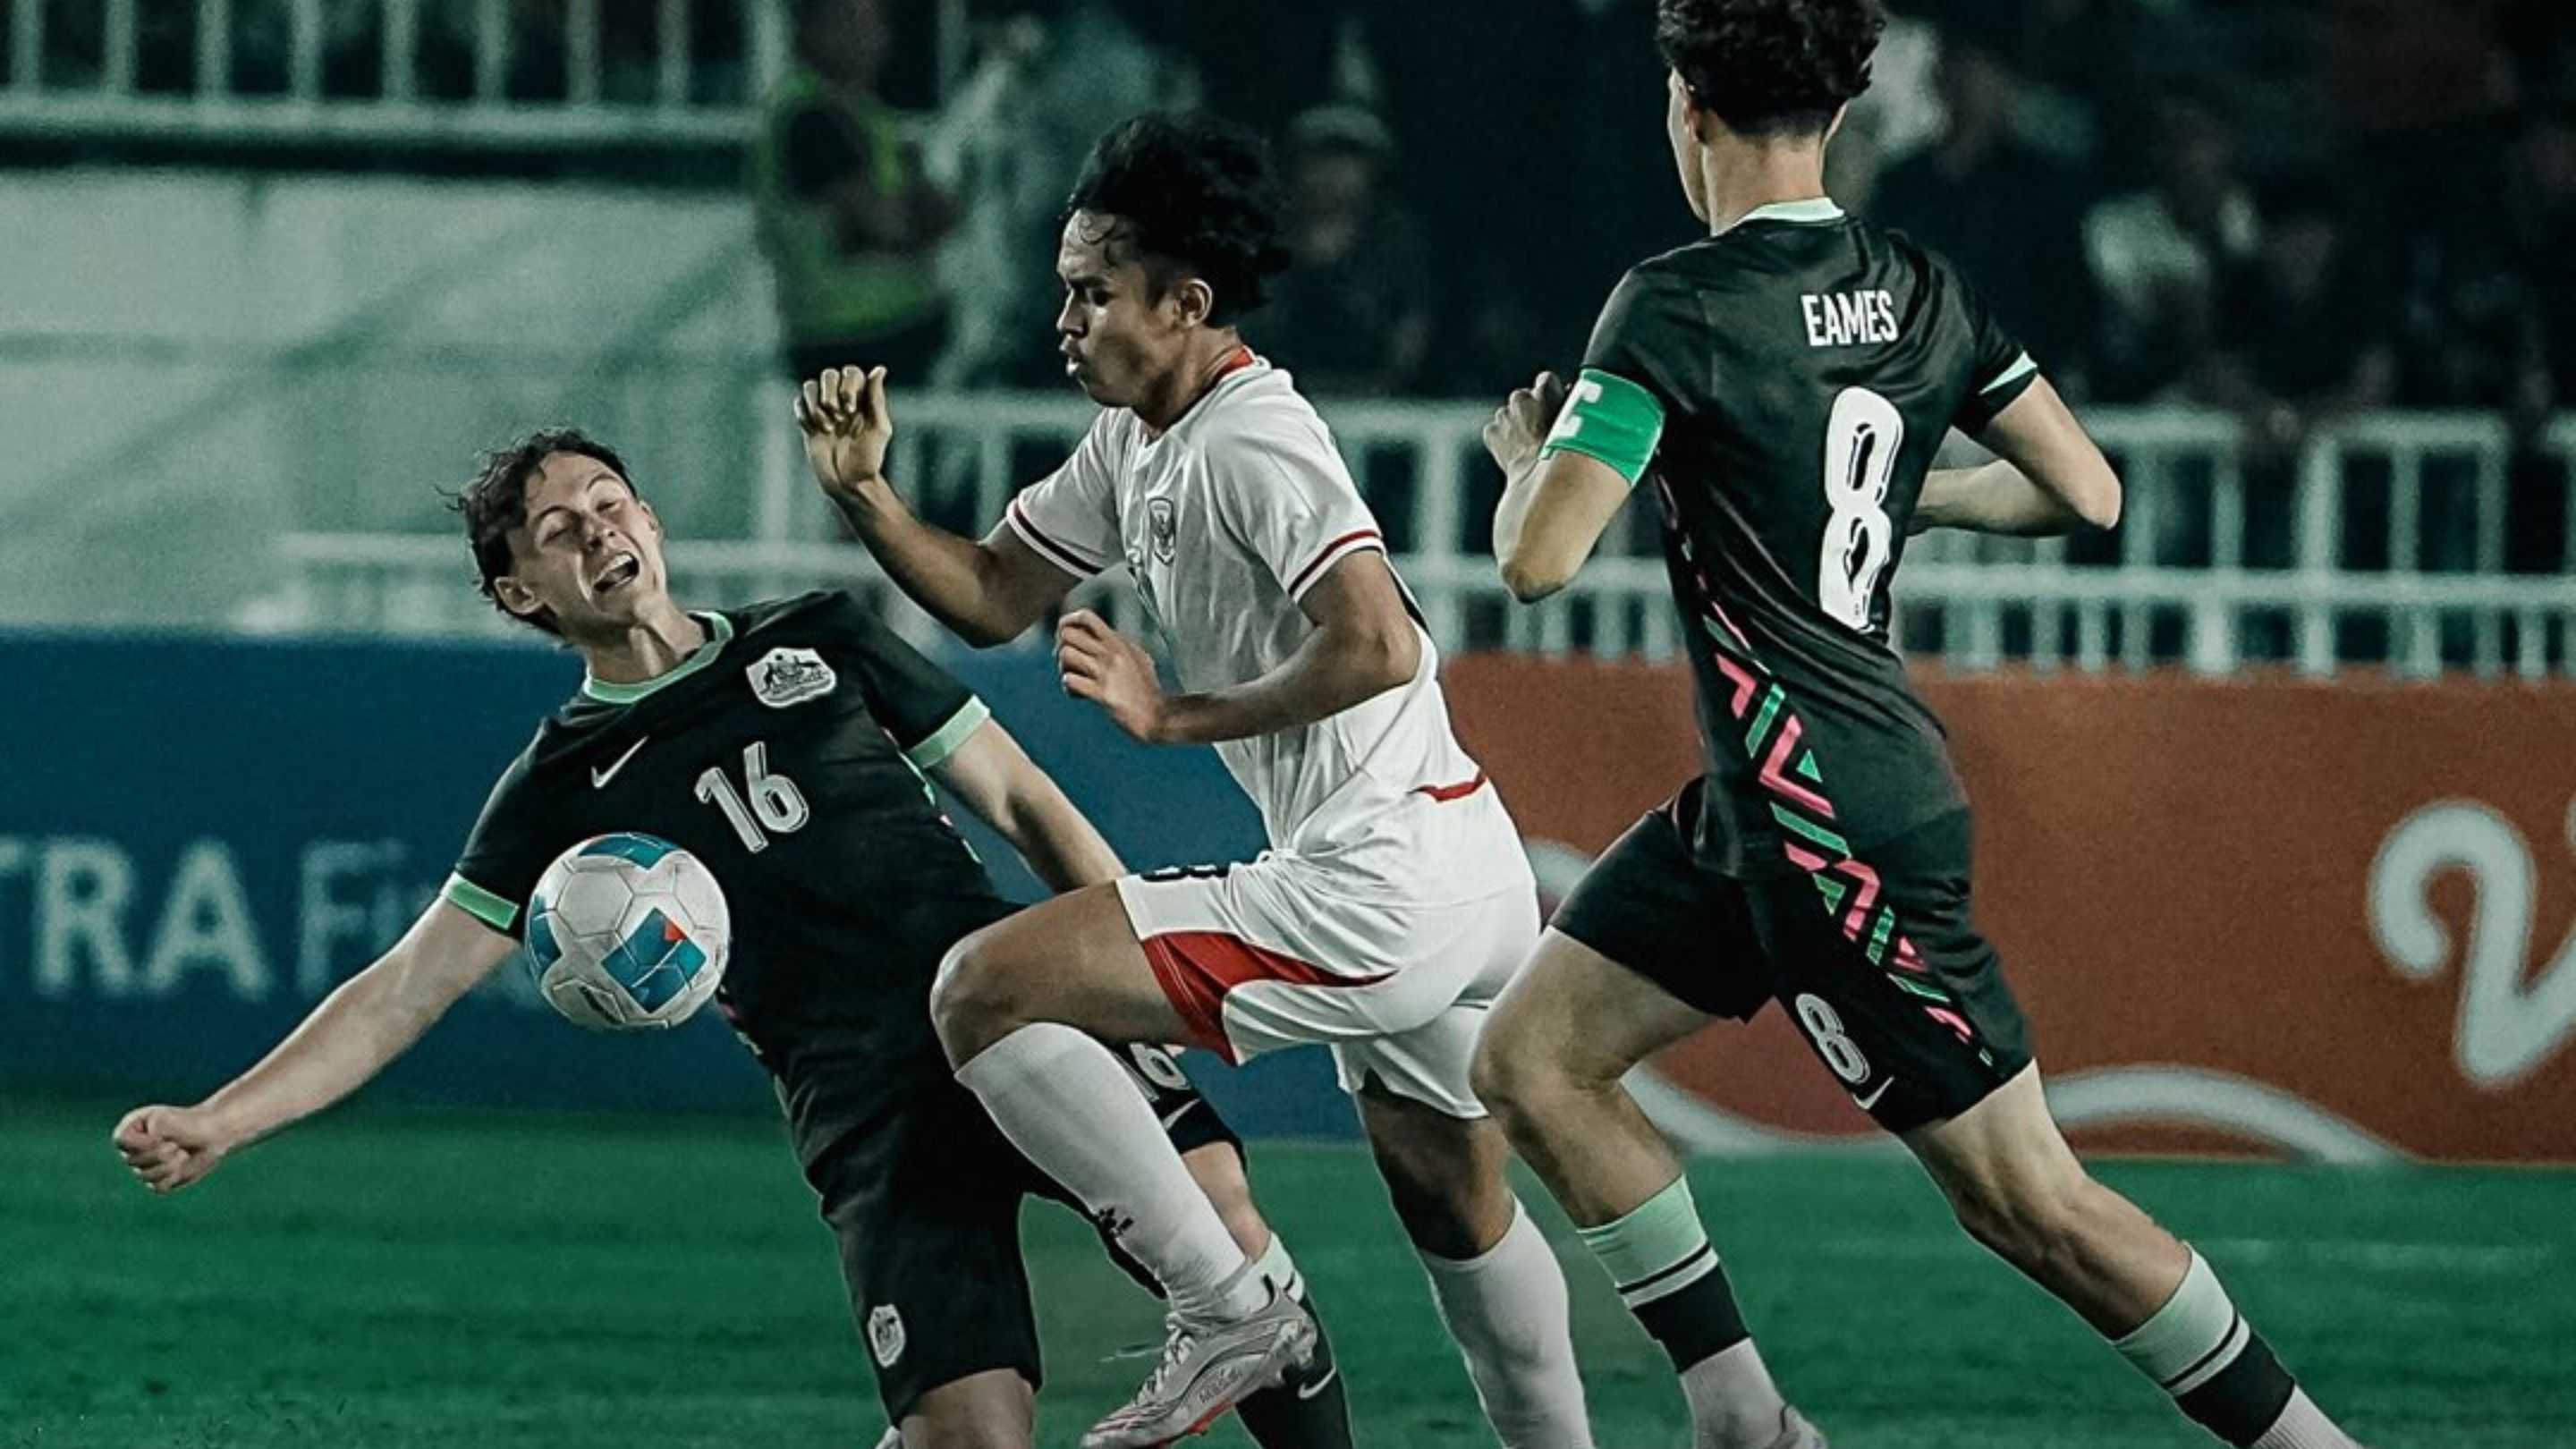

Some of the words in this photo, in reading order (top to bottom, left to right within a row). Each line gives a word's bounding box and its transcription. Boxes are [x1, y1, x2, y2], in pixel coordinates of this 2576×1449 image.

[1801, 290, 1899, 347] EAMES
[1818, 386, 1904, 634] 8
[694, 740, 809, 853] 16
[1795, 992, 1871, 1085] 8
